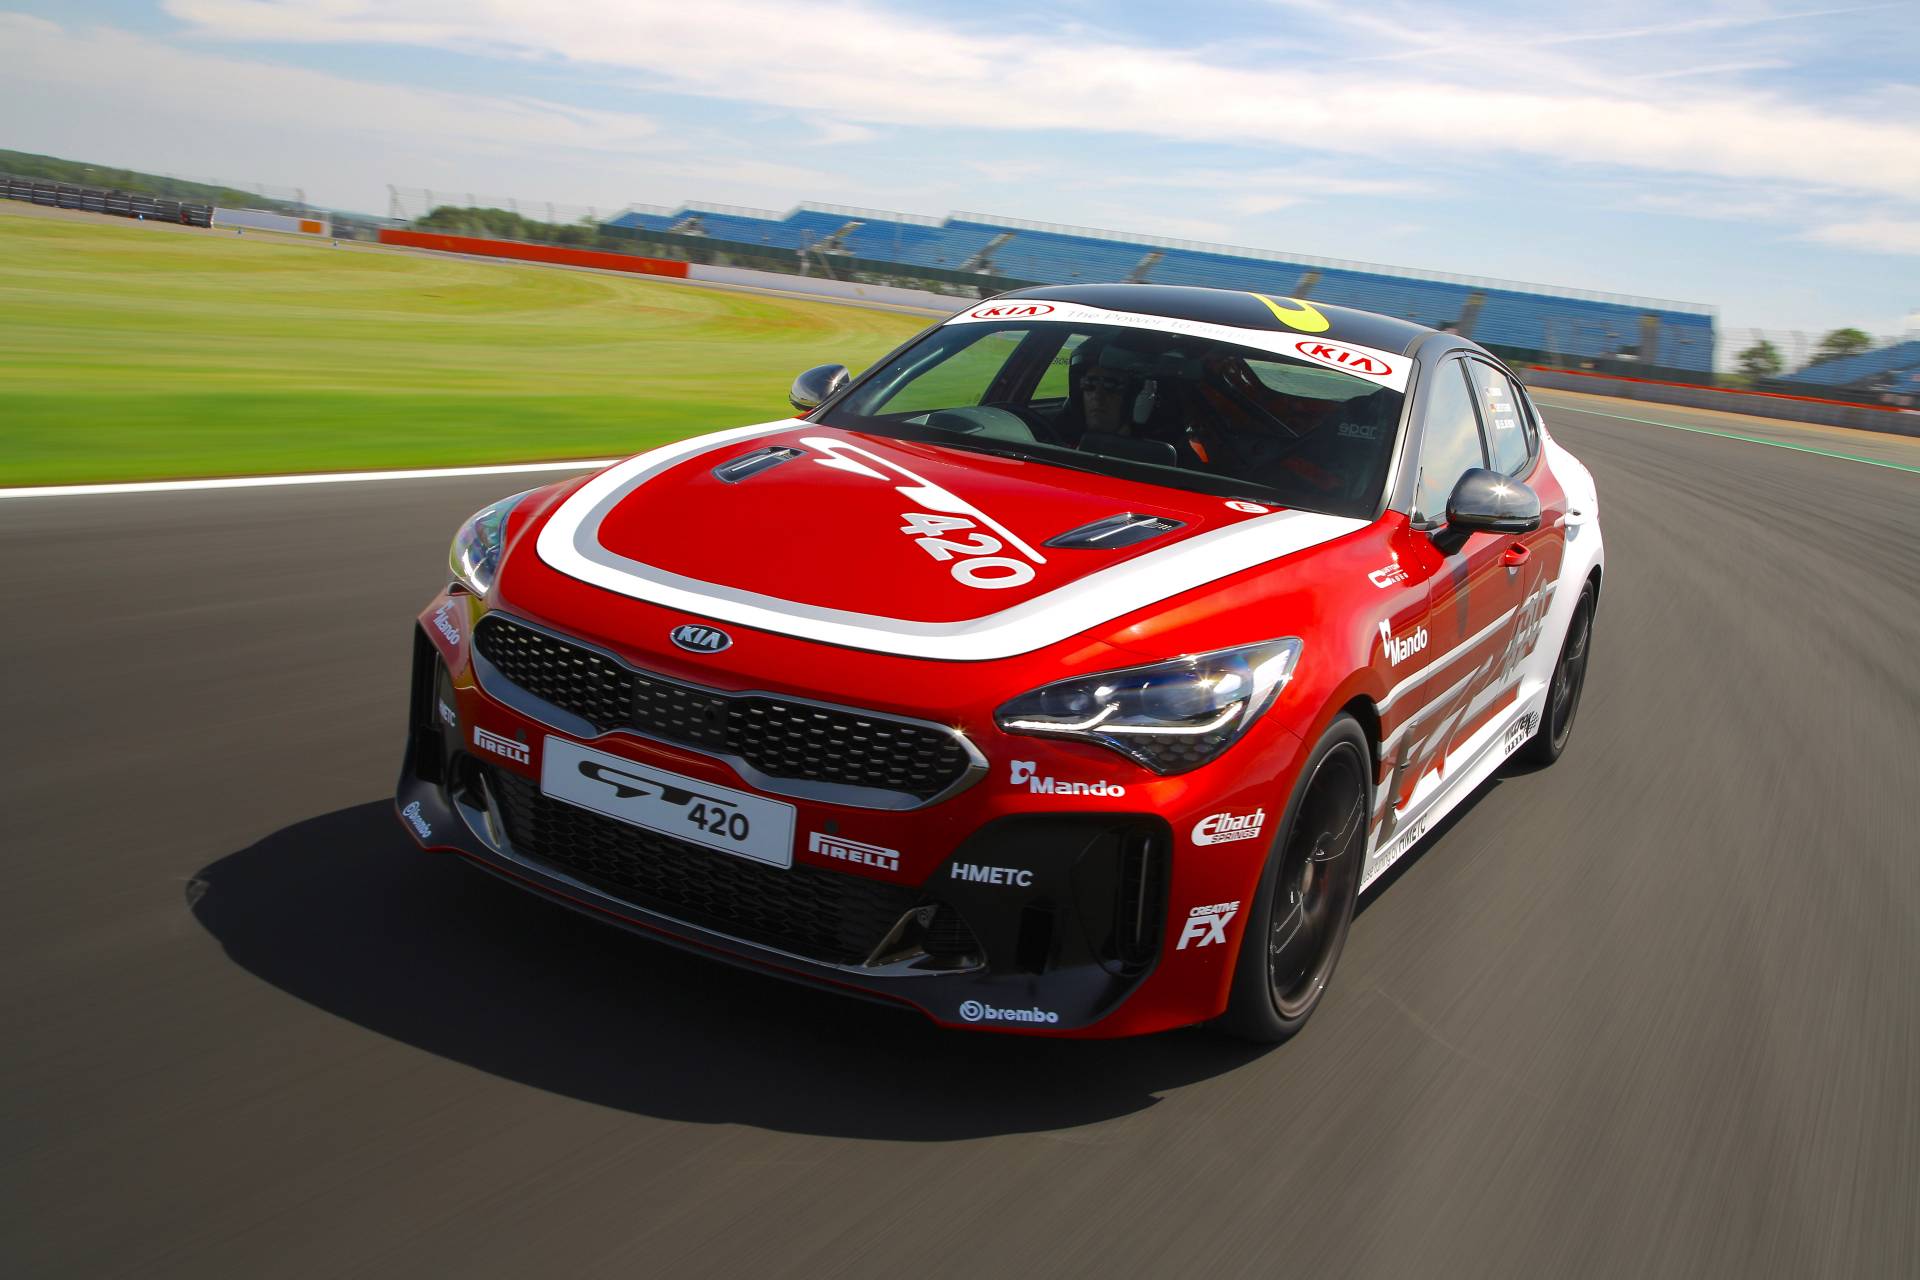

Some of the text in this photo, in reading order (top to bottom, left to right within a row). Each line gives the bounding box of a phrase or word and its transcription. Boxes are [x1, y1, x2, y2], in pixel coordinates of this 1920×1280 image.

[984, 306, 1038, 316] KIA
[1067, 310, 1100, 319] The
[1104, 312, 1162, 326] Power
[1310, 344, 1373, 372] KIA
[900, 512, 1036, 589] 420
[433, 611, 461, 646] Mando
[676, 625, 720, 649] KIA
[1390, 626, 1428, 667] Mando
[473, 726, 530, 766] PIRELLI
[1029, 776, 1126, 798] Mando
[687, 803, 749, 841] 420
[1191, 808, 1266, 842] Eibach
[1211, 828, 1257, 844] SPRINGS
[809, 831, 900, 871] PIRELLI
[951, 862, 1034, 887] HMETC
[1189, 901, 1240, 917] CREATIVE
[1176, 911, 1236, 950] FX
[984, 1005, 1059, 1024] brembo
